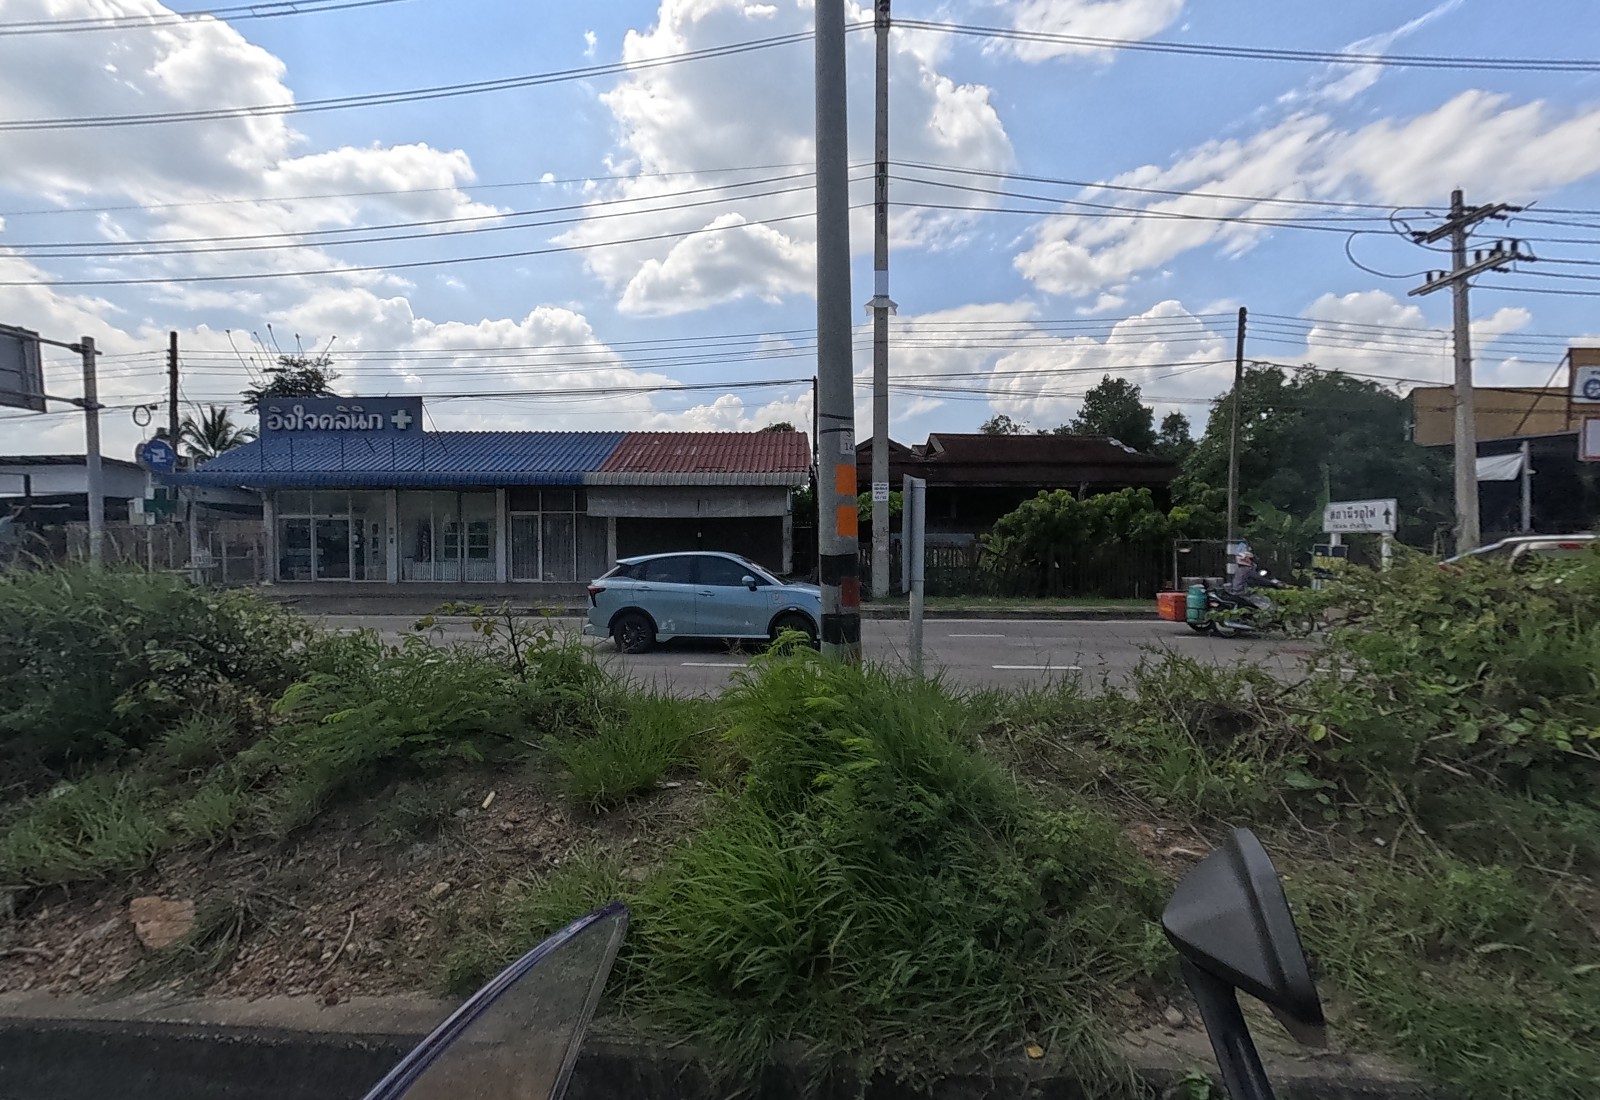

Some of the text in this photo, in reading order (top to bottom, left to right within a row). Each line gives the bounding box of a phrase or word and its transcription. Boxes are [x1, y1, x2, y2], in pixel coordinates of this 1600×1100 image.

[267, 404, 383, 430] อิงใจคลินิก
